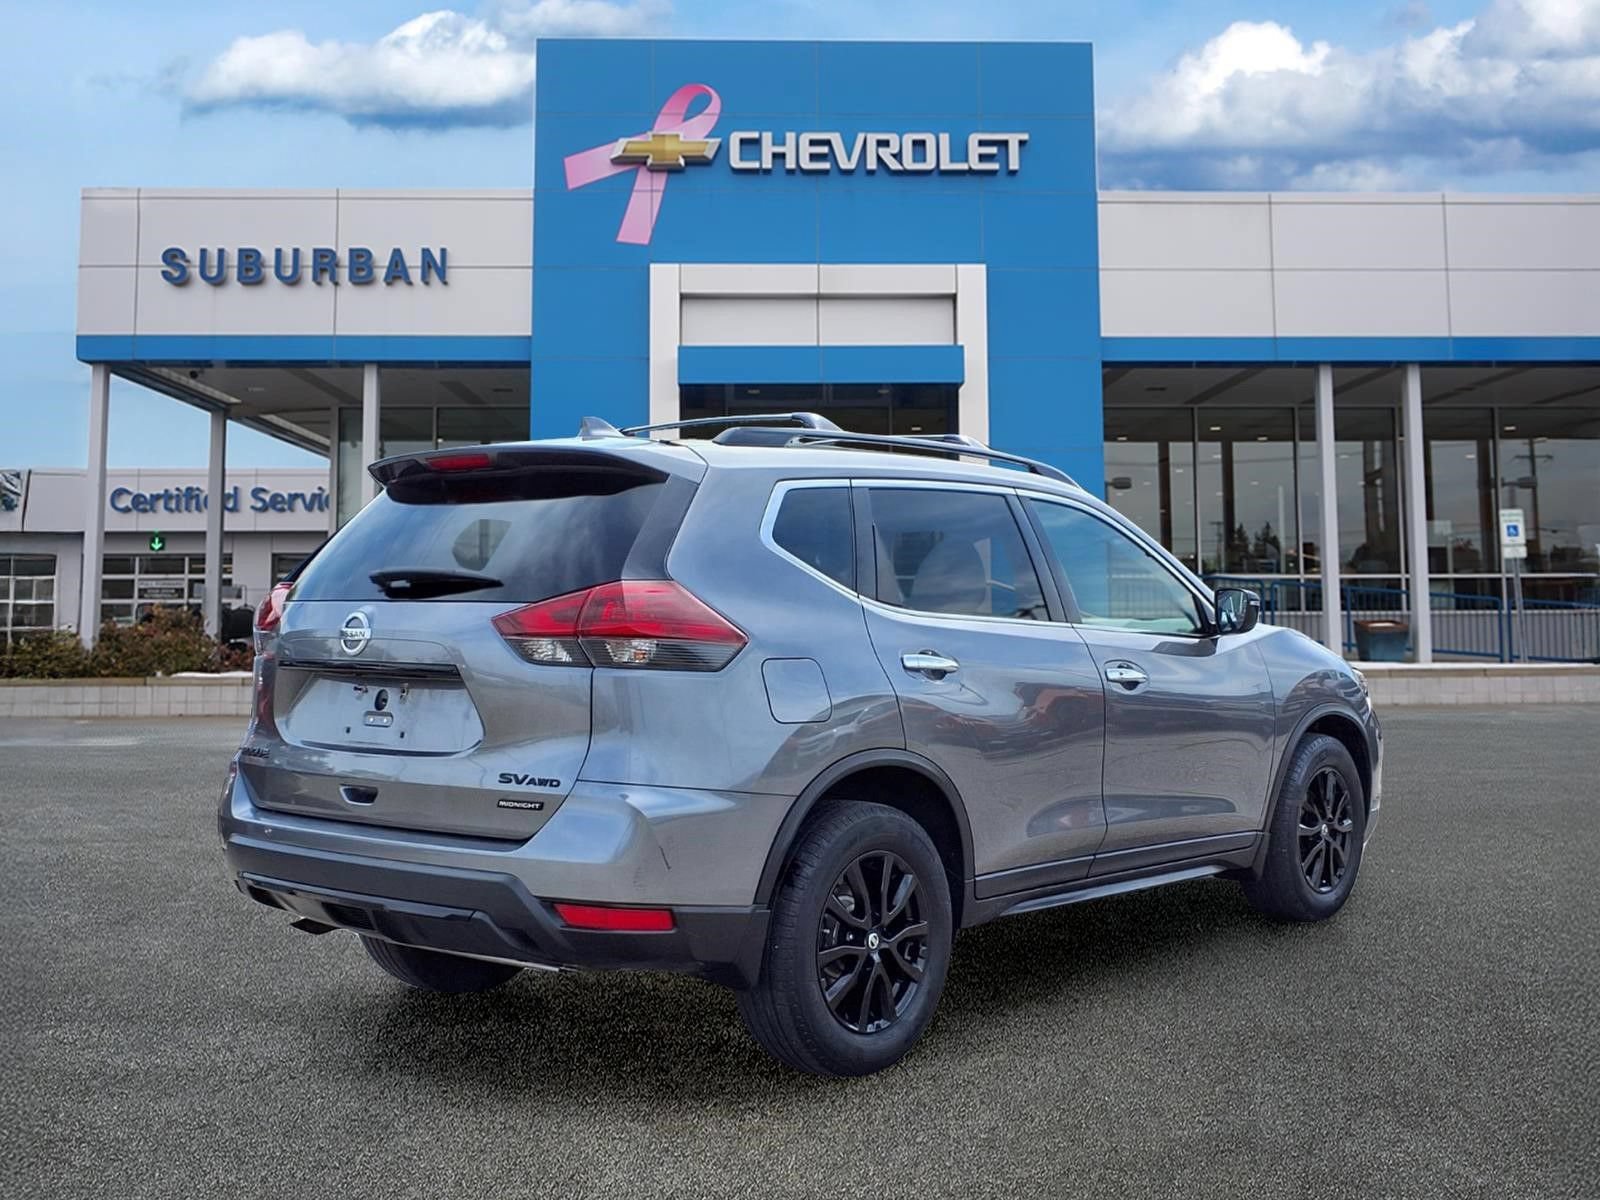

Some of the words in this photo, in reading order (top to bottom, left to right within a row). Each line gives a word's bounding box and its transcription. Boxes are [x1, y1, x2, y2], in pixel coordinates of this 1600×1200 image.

[729, 131, 1029, 172] CHEVROLET
[160, 246, 449, 286] SUBURBAN
[110, 486, 240, 514] Certifid
